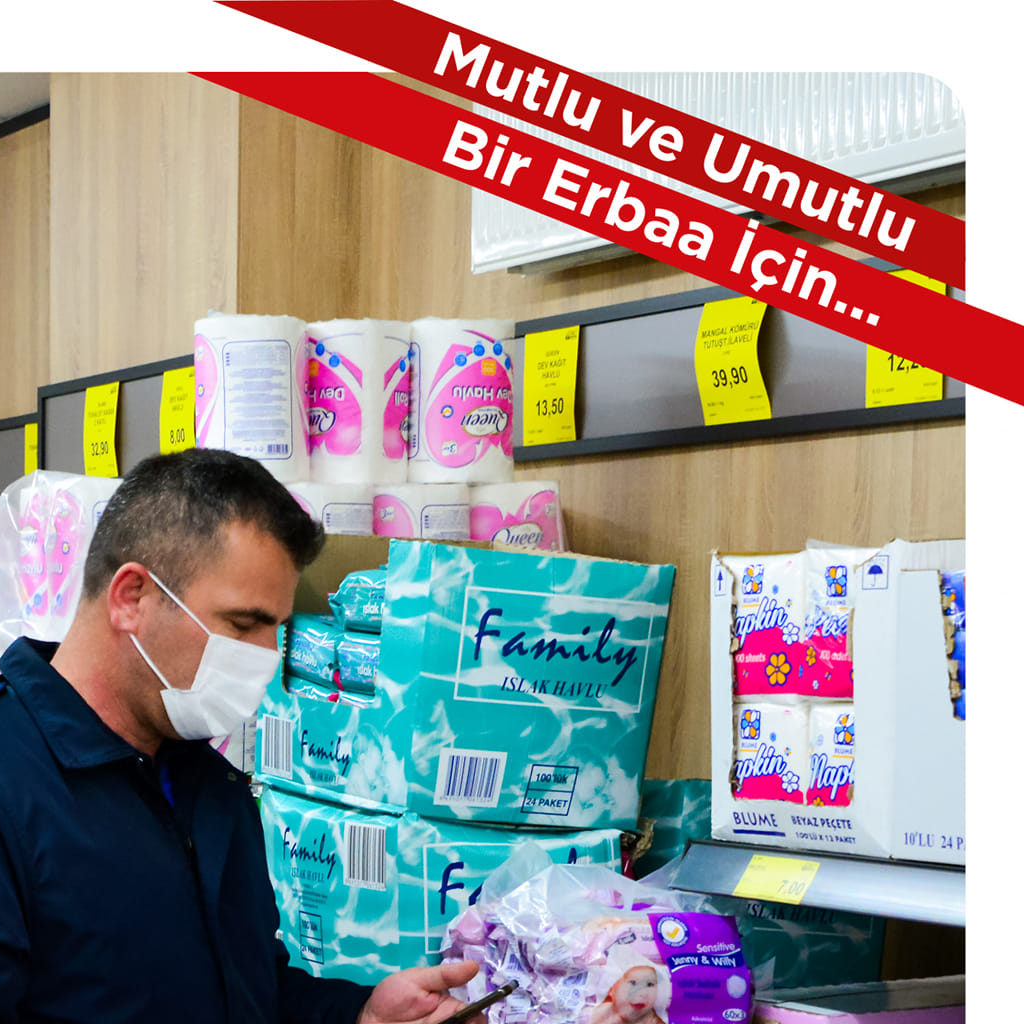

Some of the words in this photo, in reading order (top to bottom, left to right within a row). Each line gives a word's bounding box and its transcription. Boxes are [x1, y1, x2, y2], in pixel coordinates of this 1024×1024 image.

[711, 366, 749, 388] 39,90
[318, 385, 346, 401] Dev
[452, 384, 494, 403] Havlu
[535, 397, 565, 418] 13,50
[460, 406, 509, 434] Queen
[735, 597, 788, 649] apkin
[474, 607, 638, 687] Family
[500, 675, 549, 695] ISLAK
[553, 679, 609, 699] HAVLU
[300, 730, 352, 776] Family
[810, 752, 855, 800] Nap
[526, 797, 536, 807] 24
[538, 799, 569, 810] PAKET
[733, 812, 779, 828] BLUME
[791, 815, 819, 827] BEYAZ
[820, 818, 852, 831] PEÇETE
[941, 835, 953, 849] 24
[282, 827, 337, 879] Family
[747, 903, 786, 921] ISLAK
[790, 905, 837, 924] HAVLU
[696, 942, 736, 954] Sensitive
[672, 956, 699, 967] Jenny
[701, 956, 710, 965] &
[713, 957, 737, 967] Willy
